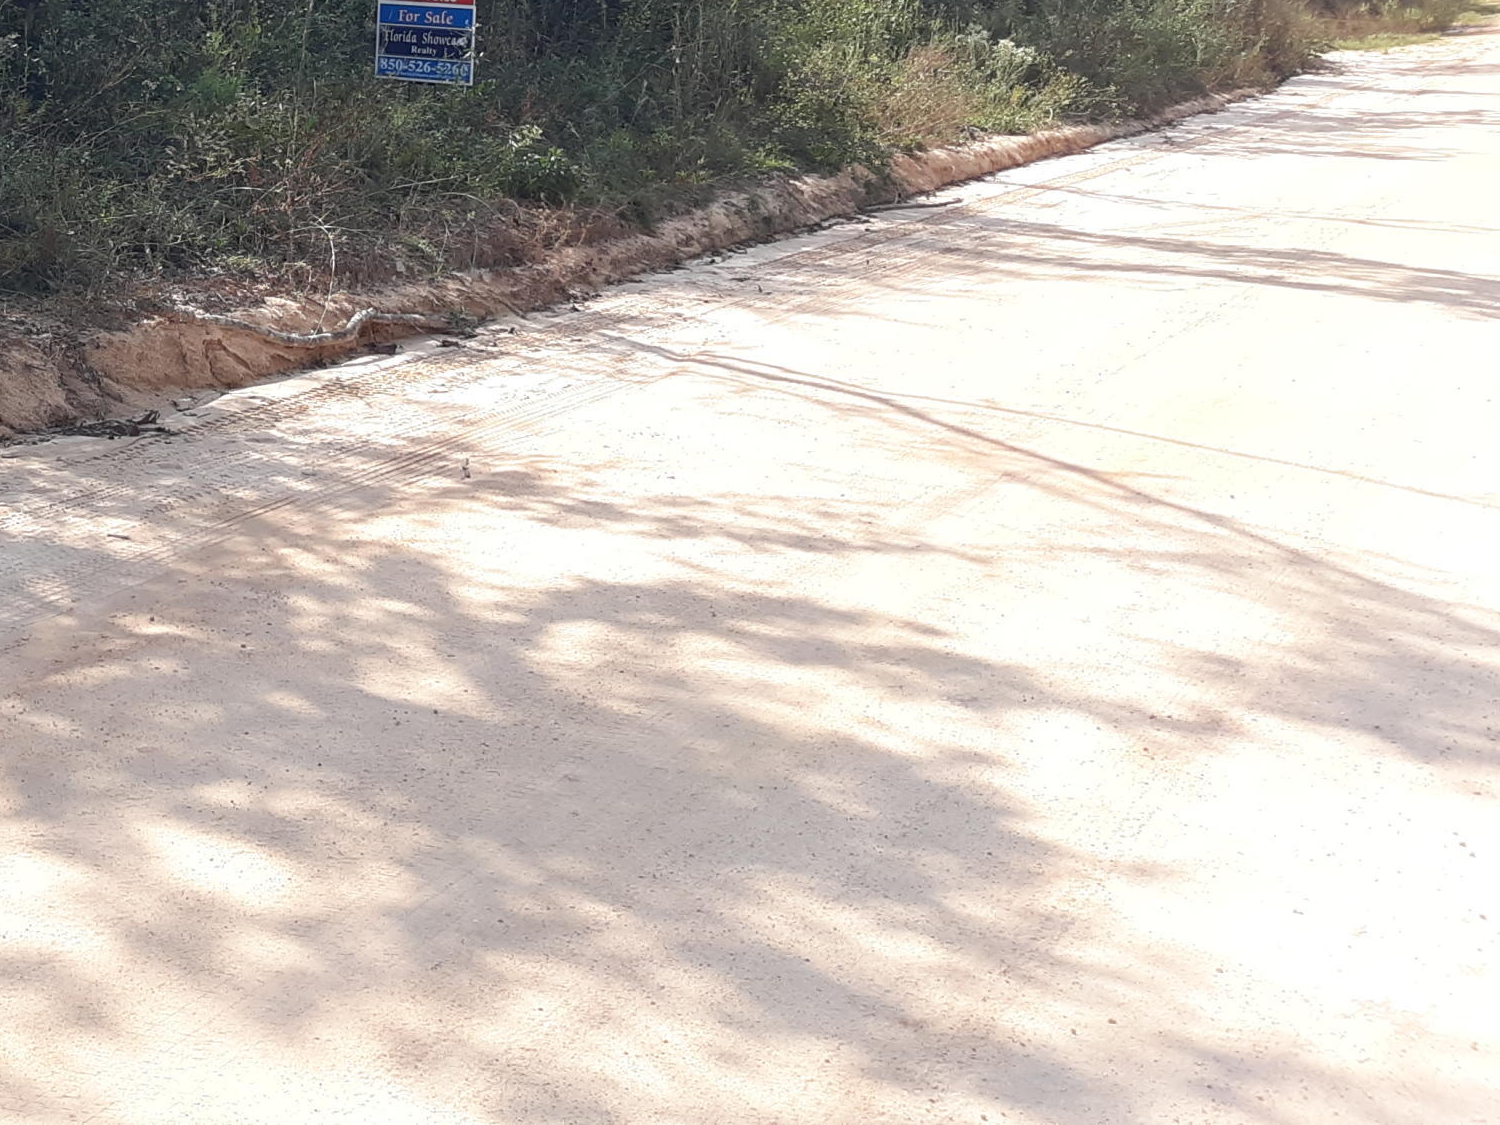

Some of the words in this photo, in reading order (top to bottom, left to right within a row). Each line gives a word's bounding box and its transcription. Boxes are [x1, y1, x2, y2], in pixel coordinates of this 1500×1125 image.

[398, 9, 420, 22] For
[424, 10, 453, 25] Sale
[383, 28, 417, 43] Florida
[421, 31, 468, 46] Showca
[411, 45, 437, 56] Realty
[380, 58, 469, 76] 850-526-5260
